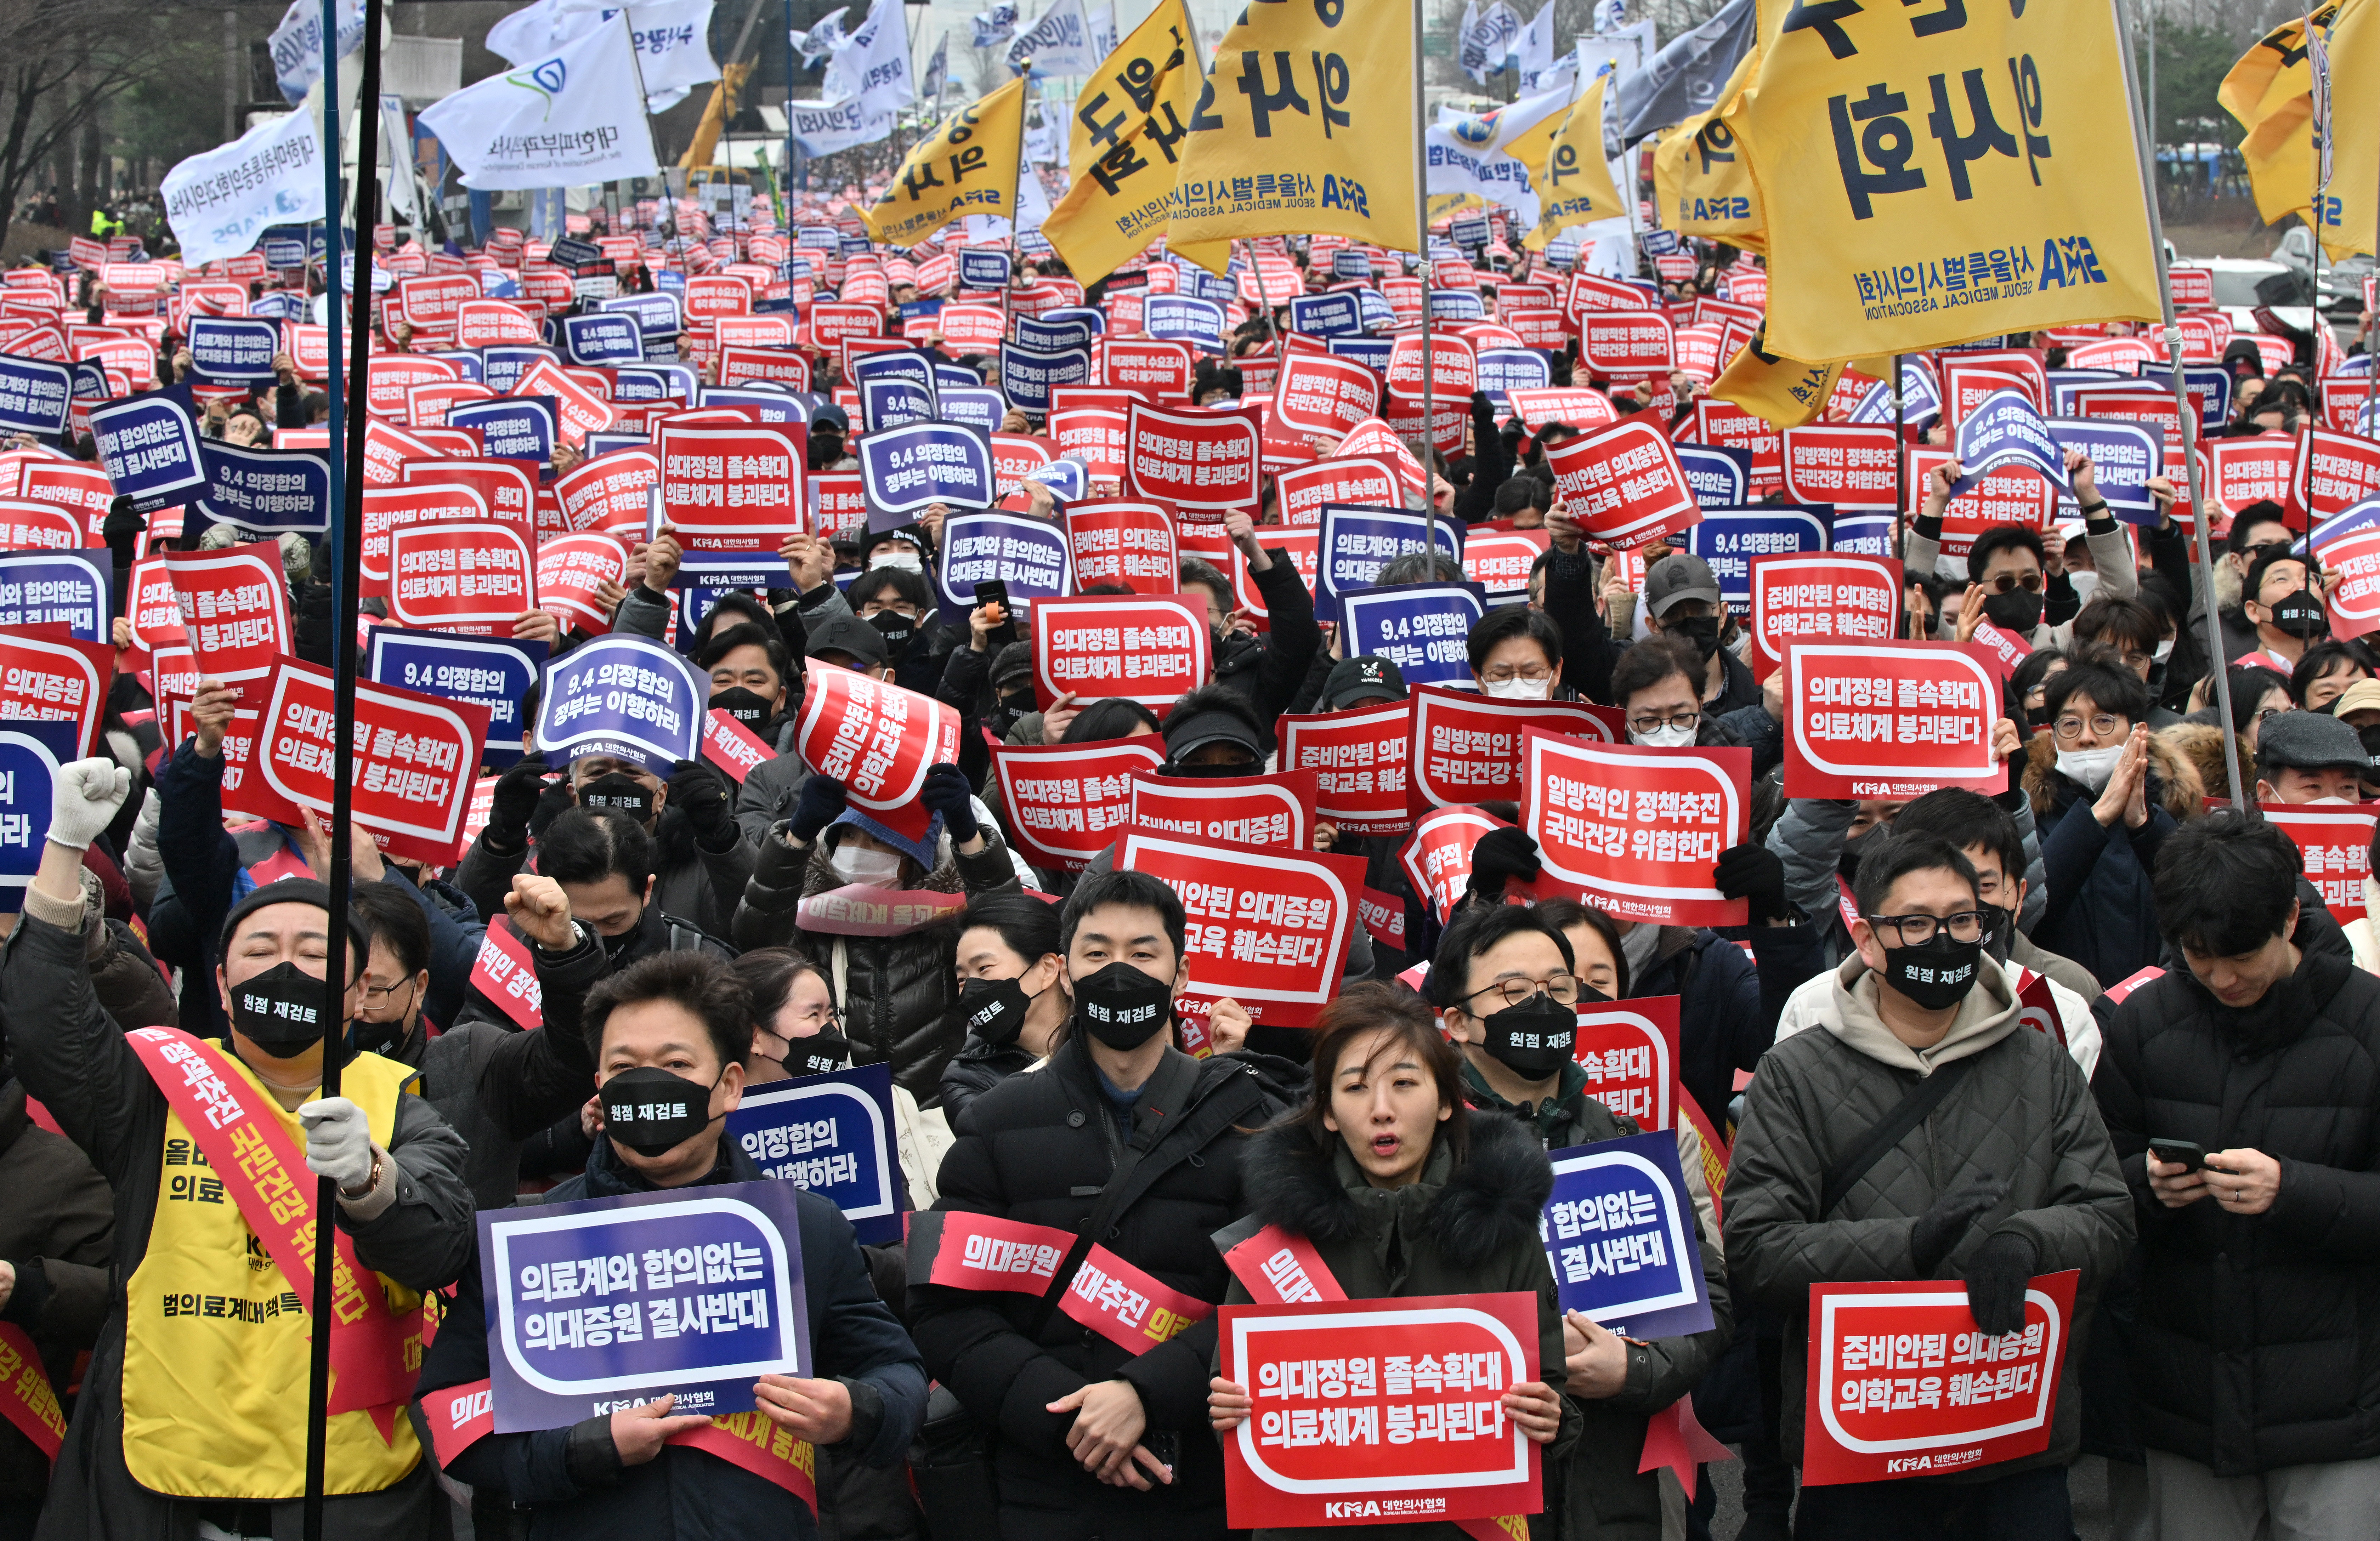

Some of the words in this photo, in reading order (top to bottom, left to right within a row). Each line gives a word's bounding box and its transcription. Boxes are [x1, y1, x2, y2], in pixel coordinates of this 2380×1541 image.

[196, 334, 232, 347] 의료계와
[234, 335, 271, 348] 합의없는
[1591, 328, 1628, 341] 일방적인
[1630, 327, 1665, 340] 정책추진
[195, 349, 232, 363] 의대증원
[233, 351, 271, 363] 결사반대
[1591, 343, 1628, 356] 국민건강
[1630, 343, 1667, 356] 위협한다
[1286, 393, 1334, 414] 국민건강
[1291, 374, 1338, 395] 일방적인
[1340, 381, 1373, 409] 정책추진
[1976, 413, 1995, 435] 9.4
[1997, 406, 2048, 438] 의정합의
[1138, 431, 1193, 460] 의대정원
[1197, 437, 1250, 461] 졸속확대
[1968, 428, 2004, 457] 정부는
[2007, 423, 2055, 459] 이행하라
[667, 455, 723, 478] 의대정원
[727, 455, 788, 478] 졸속확대
[890, 448, 914, 468] 9.4
[916, 444, 967, 464] 의정합의
[1612, 441, 1663, 477] 의대증원
[1794, 447, 1843, 466] 일방적인
[221, 466, 243, 485] 9.4
[246, 473, 305, 491] 의정합의
[885, 468, 926, 493] 정부는
[928, 465, 977, 486] 이행하라
[1137, 455, 1191, 484] 의료체계
[1195, 462, 1250, 485] 붕괴된다
[1795, 469, 1843, 488] 국민건강
[213, 483, 251, 509] 정부는
[255, 495, 314, 512] 이행하라
[666, 483, 723, 506] 의료체계
[727, 484, 790, 507] 붕괴된다
[1620, 466, 1674, 503] 훼손된다
[693, 538, 722, 548] KMA
[724, 539, 759, 548] 대한의사협회
[952, 536, 1000, 558] 의료계와
[1003, 538, 1061, 567] 합의없는
[1716, 534, 1739, 553] 9.4
[1741, 533, 1799, 553] 의정합의
[401, 549, 455, 573] 의대정원
[459, 548, 520, 570] 졸속확대
[401, 575, 456, 599] 의료체계
[460, 574, 522, 596] 붕괴된다
[950, 560, 997, 582] 의대증원
[1000, 561, 1059, 590] 결사반대
[1768, 585, 1832, 609] 준비안된
[1836, 585, 1889, 612] 의대증원
[1053, 628, 1120, 652] 의대정원
[1123, 626, 1190, 650] 졸속확대
[1768, 613, 1832, 636] 의학교육
[1836, 613, 1888, 639] 훼손된다
[1054, 656, 1121, 679] 의료체계
[1125, 654, 1191, 678] 붕괴된다
[4, 668, 85, 705] 의대증원
[568, 668, 594, 695] 9.4
[597, 664, 674, 710] 의정합의
[1810, 677, 1892, 706] 의대정원
[1898, 679, 1979, 709] 졸속확대
[554, 693, 602, 726] 정부는
[607, 681, 680, 736] 이행하라
[1810, 712, 1892, 742] 의료체계
[1897, 715, 1981, 744] 붕괴된다
[372, 727, 459, 772] 졸속확대
[570, 743, 603, 758] KMA
[605, 744, 646, 762] 대한의사협회
[853, 717, 907, 796] 의학교육
[363, 762, 449, 807] 붕괴된다
[1853, 783, 1891, 795] KMA
[589, 795, 606, 807] 원점
[611, 797, 641, 808] 재검토
[1548, 775, 1630, 820] 일방적인
[1635, 791, 1720, 824] 정책추진
[1546, 810, 1627, 857] 국민건강
[1631, 830, 1720, 863] 위협한다
[1236, 891, 1331, 930] 의대증원
[1581, 893, 1620, 912] KMA
[1623, 901, 1671, 915] 대한의사협회
[1231, 929, 1322, 967] 훼손된다
[1905, 966, 1933, 983] 원점
[1940, 962, 1972, 986] 재검토
[244, 994, 268, 1014] 원점
[274, 1002, 316, 1023] 재검토
[1088, 1002, 1110, 1022] 원점
[1116, 1004, 1156, 1023] 재검토
[1510, 1032, 1539, 1048] 원점
[1546, 1031, 1571, 1048] 재검토
[611, 1105, 633, 1121] 원점
[638, 1103, 687, 1120] 재검토
[160, 1041, 245, 1130] 정책추진
[230, 1122, 308, 1225] 국민건강
[290, 1226, 370, 1326] 위한다
[1551, 1190, 1657, 1239] 합의없는
[962, 1234, 1061, 1277] 의대정원
[1560, 1230, 1667, 1283] 결사반대
[521, 1253, 638, 1302] 의료계와
[642, 1242, 763, 1290] 합의없는
[525, 1302, 643, 1350] 의대증원
[648, 1289, 769, 1339] 결사반대
[1842, 1334, 1946, 1370] 준비안된
[1259, 1357, 1377, 1400] 의대정원
[1384, 1352, 1502, 1395] 졸속확대
[1840, 1377, 1942, 1414] 의학교육
[1947, 1362, 2037, 1406] 훼손된다
[1261, 1406, 1379, 1448] 의료체계
[1386, 1400, 1505, 1444] 붕괴된다
[1887, 1456, 1931, 1473] KMA
[1934, 1448, 1982, 1464] 대한의사협회
[1326, 1501, 1381, 1518] KMA
[1383, 1498, 1446, 1510] 대한의사협회
